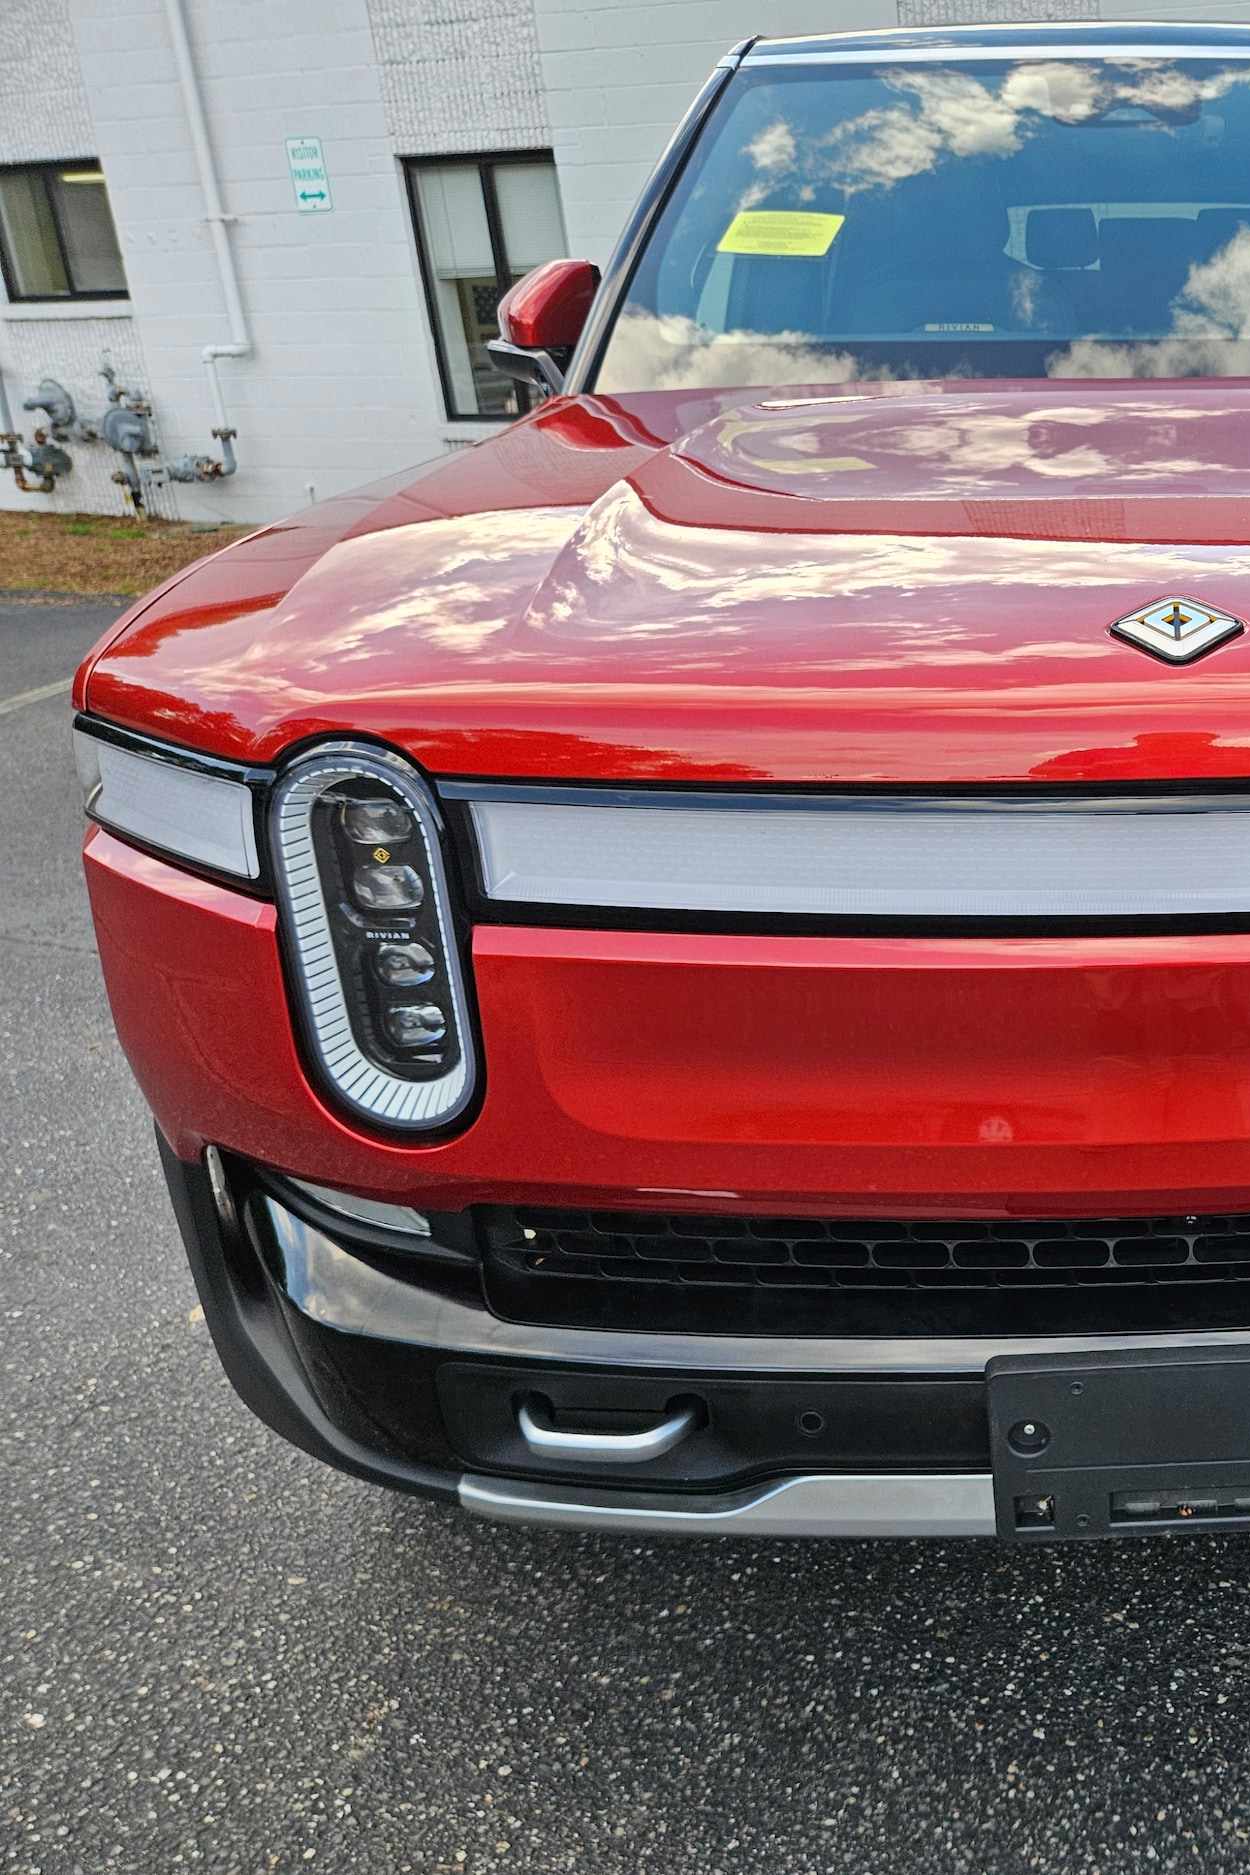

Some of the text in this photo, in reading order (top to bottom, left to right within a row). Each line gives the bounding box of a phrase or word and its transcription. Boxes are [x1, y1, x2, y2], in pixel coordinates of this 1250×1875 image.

[291, 146, 318, 160] VISITOR
[293, 168, 325, 181] PARKING
[366, 931, 410, 939] RIVIAN
